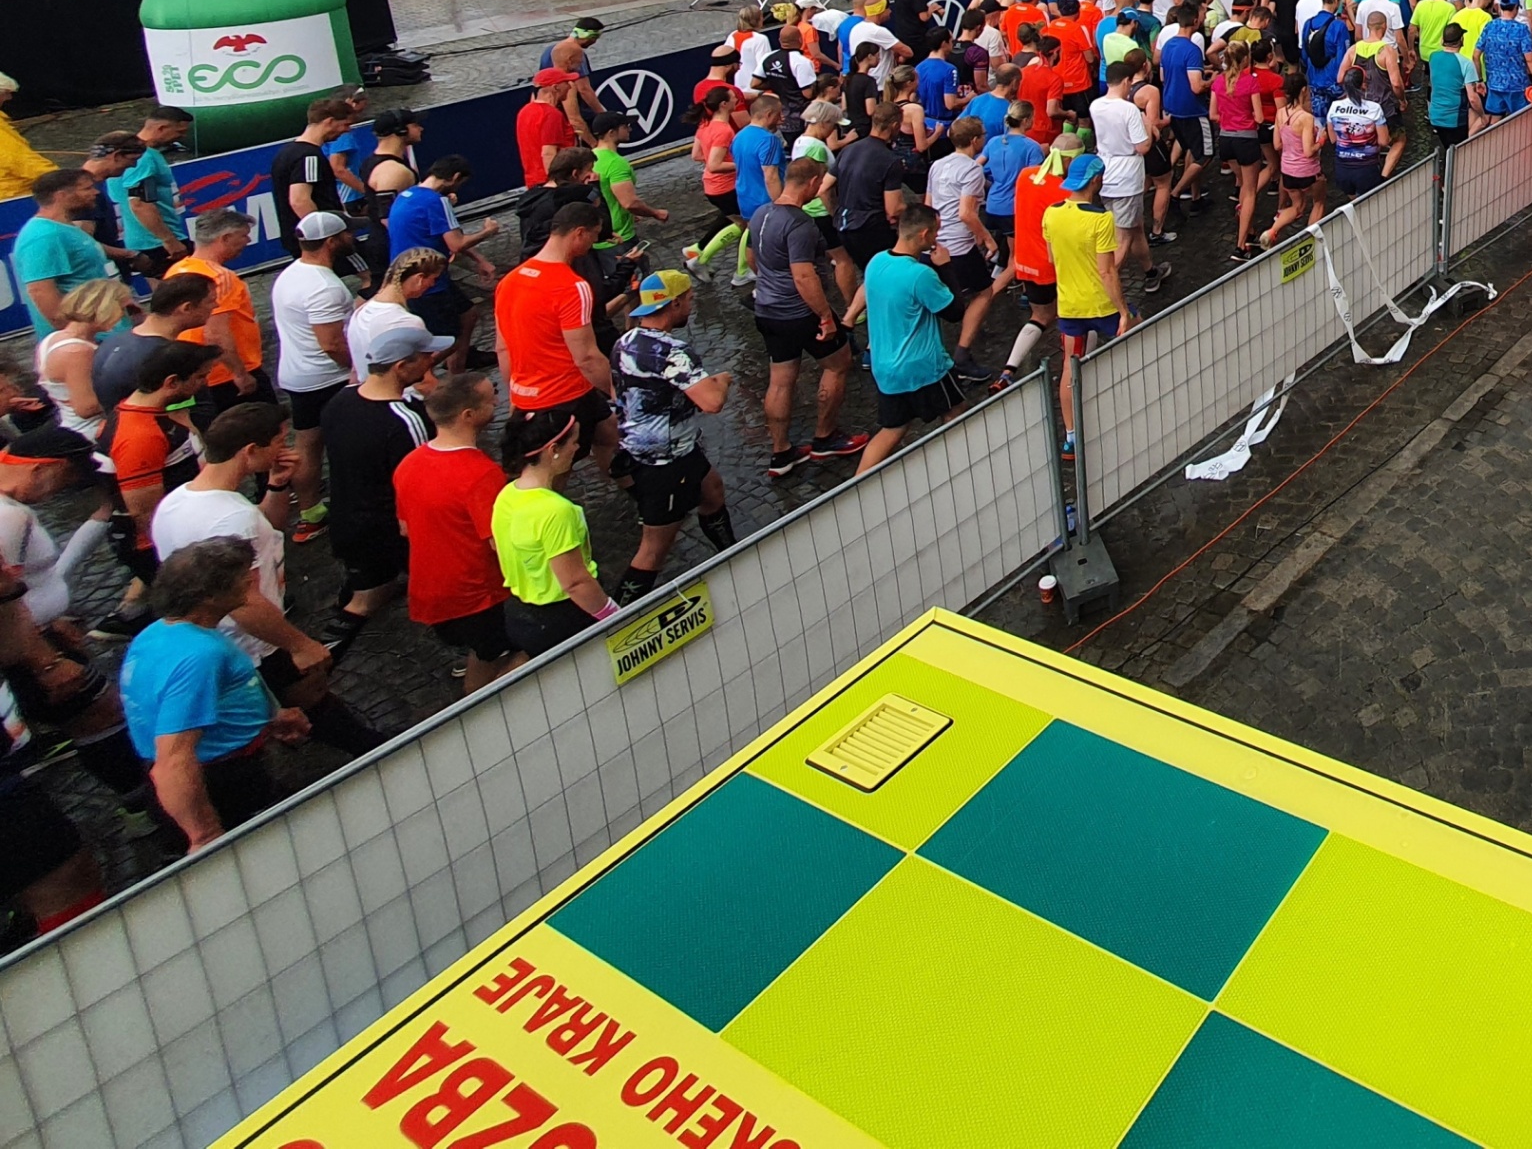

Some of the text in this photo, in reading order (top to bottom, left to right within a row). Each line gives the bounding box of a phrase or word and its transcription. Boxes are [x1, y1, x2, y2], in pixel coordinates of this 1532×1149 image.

[188, 54, 307, 93] ECO
[1335, 105, 1369, 115] Follow
[616, 607, 707, 676] JOHNNY SERVIS
[472, 956, 638, 1077] KRAJE
